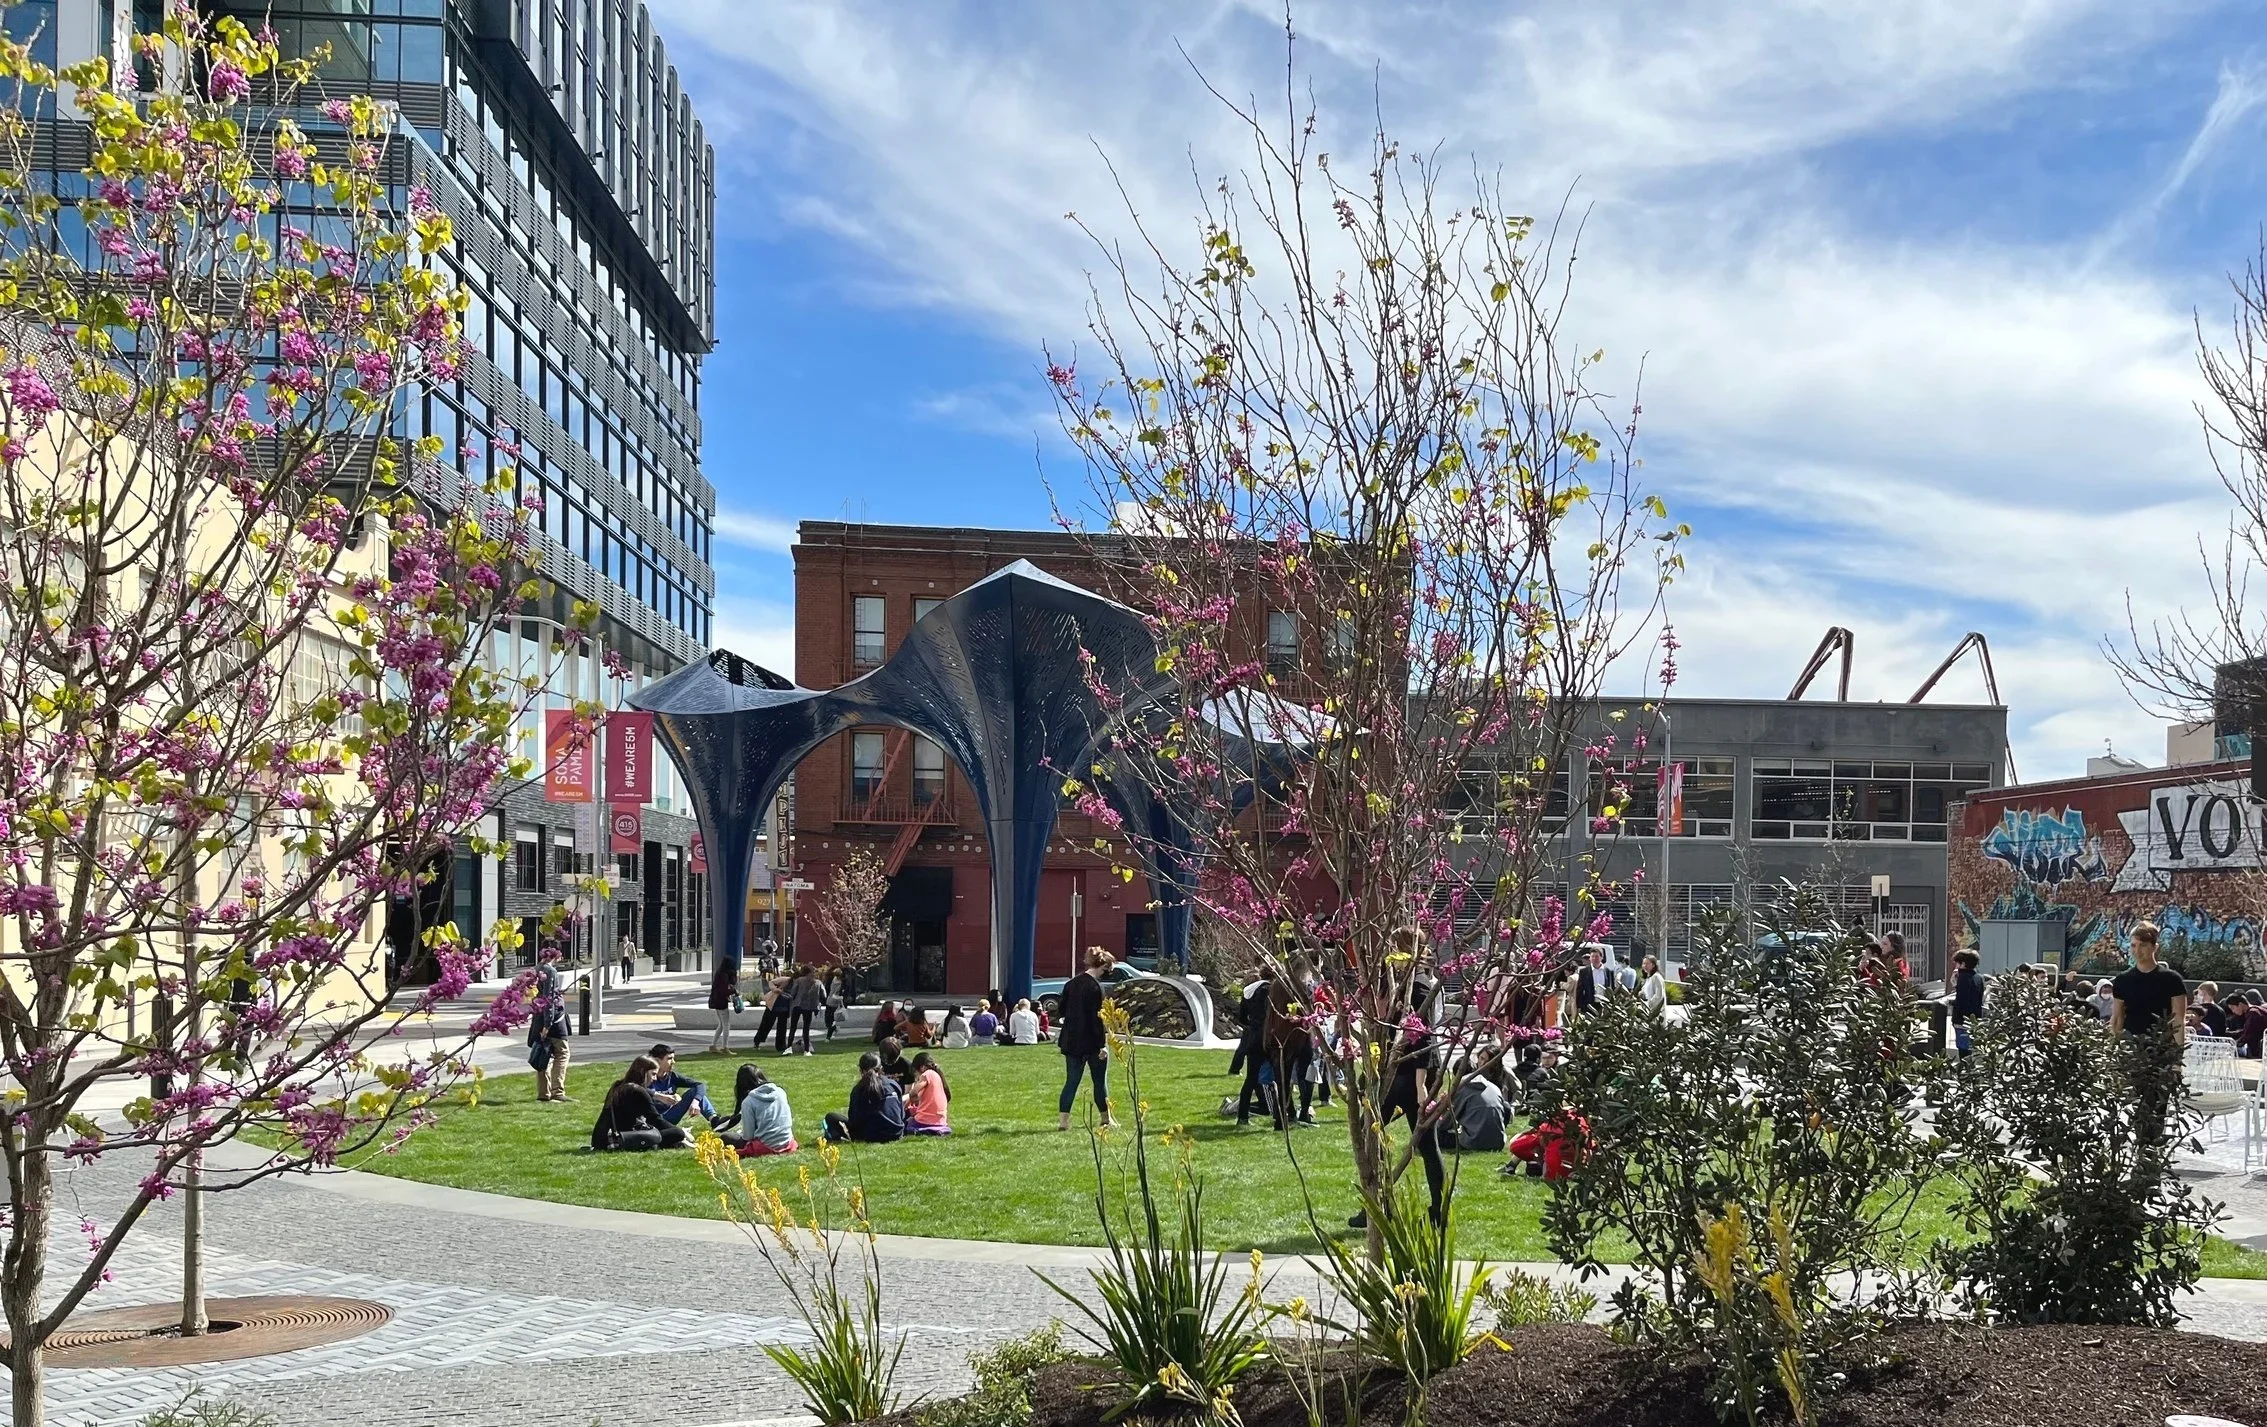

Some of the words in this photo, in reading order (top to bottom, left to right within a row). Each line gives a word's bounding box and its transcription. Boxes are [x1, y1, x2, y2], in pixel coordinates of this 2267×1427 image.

[555, 747, 568, 785] SOMA
[624, 727, 636, 788] #WEARE5M
[2156, 794, 2267, 860] VO
